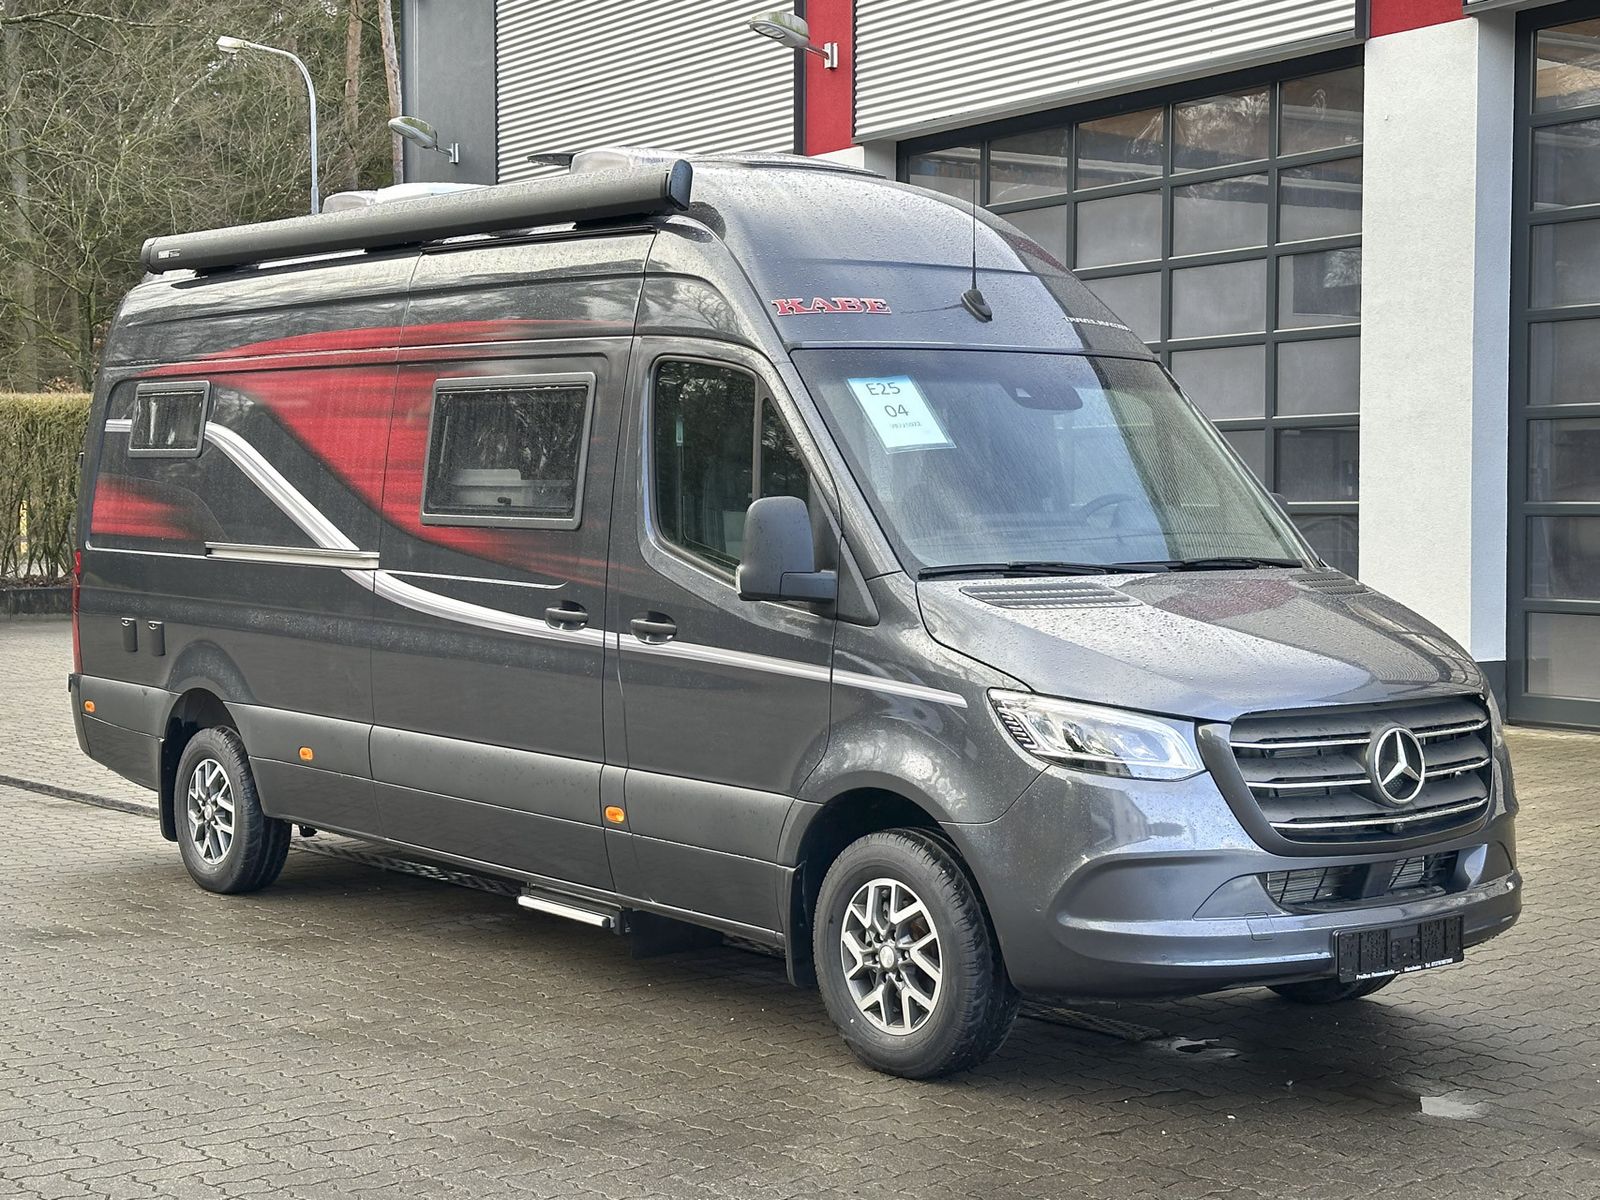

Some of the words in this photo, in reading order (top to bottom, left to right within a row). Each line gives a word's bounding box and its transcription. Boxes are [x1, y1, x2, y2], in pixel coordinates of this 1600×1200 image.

[771, 297, 892, 316] KABE
[865, 382, 901, 396] E25
[884, 404, 909, 417] 04
